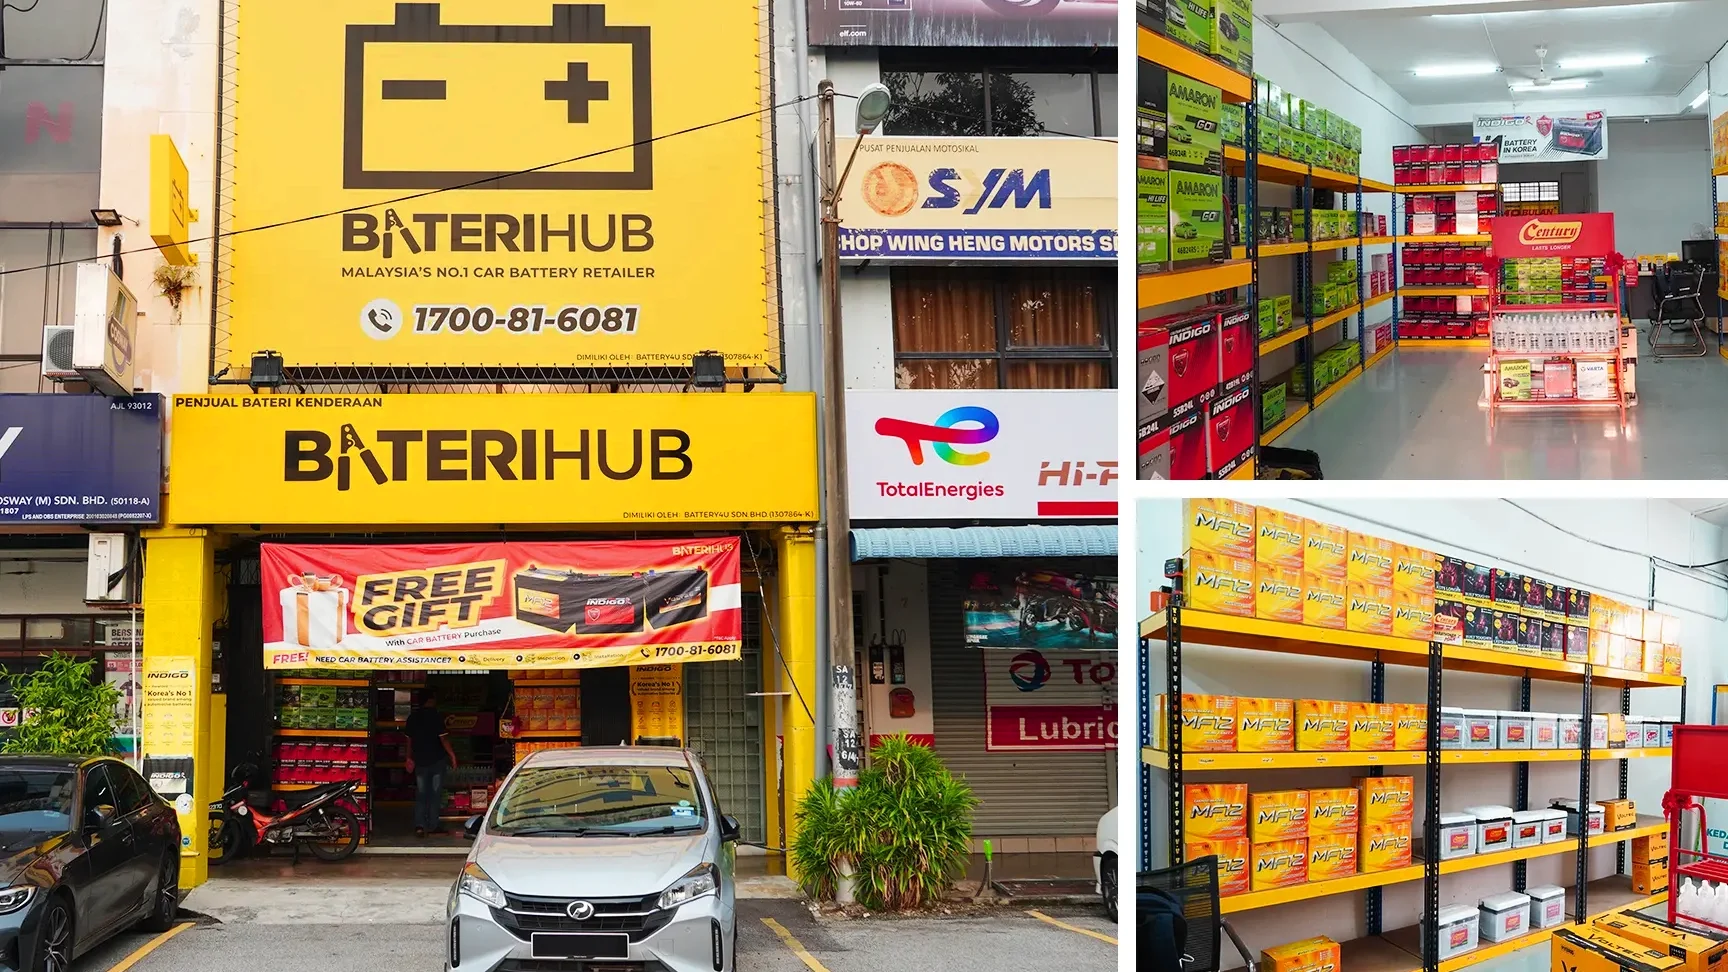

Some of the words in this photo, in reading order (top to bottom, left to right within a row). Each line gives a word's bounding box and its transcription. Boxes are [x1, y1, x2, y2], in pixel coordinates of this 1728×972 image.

[1195, 5, 1208, 18] LIFE
[1169, 82, 1216, 109] AMARON
[25, 101, 73, 145] N
[1196, 119, 1213, 131] GO
[859, 144, 883, 153] PUSAT
[886, 144, 931, 153] PENJUALAN
[933, 144, 979, 153] MOTOSIKAL
[921, 168, 1052, 215] SYM
[1176, 180, 1219, 197] AMARON
[1155, 195, 1166, 203] LIFE
[1201, 211, 1216, 222] GO
[342, 208, 655, 258] BATERIHUB
[1523, 223, 1578, 240] Century
[887, 235, 944, 251] WING
[949, 235, 1004, 251] HENG
[1010, 235, 1095, 251] MOTORS
[342, 266, 432, 278] MALAYSIA'S
[437, 266, 469, 278] NO.1
[473, 266, 505, 278] CAR
[510, 266, 578, 278] BATTERY
[583, 266, 655, 278] RETAILER
[414, 306, 638, 332] 1700-81-6081
[1224, 312, 1250, 328] INDIGO
[1169, 322, 1211, 346] INDIGO
[576, 353, 608, 361] DIMILIKI
[636, 353, 681, 361] BATTERY4U
[110, 402, 125, 411] AJL
[127, 401, 152, 410] 93012
[176, 397, 238, 408] PENJUAL
[242, 397, 292, 408] BATERI
[296, 397, 383, 408] KENDERAAN
[1212, 389, 1250, 416] INDIGO
[283, 423, 693, 491] BATERIHUB
[876, 481, 1004, 500] TotalEnergies
[35, 496, 51, 506] (M)
[54, 496, 79, 505] SDN.
[82, 496, 107, 505] BHD.
[110, 497, 150, 506] (50118-A)
[1195, 512, 1253, 538] MF12
[1260, 526, 1302, 545] MF12
[1308, 537, 1345, 555] MF12
[1351, 549, 1392, 569] MF12
[1397, 561, 1434, 579] MF12
[362, 566, 496, 605] FREE
[1195, 571, 1253, 594] MF12
[1260, 582, 1302, 599] MF12
[1306, 589, 1344, 605] MF12
[363, 594, 483, 631] GIFT
[1351, 599, 1392, 617] MF12
[1396, 607, 1432, 624] MF12
[385, 638, 406, 647] With
[406, 637, 424, 645] CAR
[425, 632, 462, 643] BATTERY
[464, 628, 502, 639] Purchase
[273, 652, 309, 664] FREE!
[395, 656, 452, 664] ASSISTANCE?
[655, 644, 737, 657] 1700-81-6081
[836, 665, 848, 673] SA
[1242, 717, 1292, 731] MF12
[1303, 718, 1349, 732] MF12
[1353, 719, 1394, 732] MF12
[843, 730, 855, 739] SA
[844, 739, 855, 748] 12
[1370, 790, 1411, 804] MF12
[1191, 803, 1244, 819] MF12
[1258, 807, 1306, 824] MF12
[1313, 804, 1357, 818] MF12
[1369, 836, 1409, 852] MF12
[1257, 853, 1305, 872] MF12
[1312, 847, 1354, 863] MF12
[1588, 933, 1645, 959] VOLTEC
